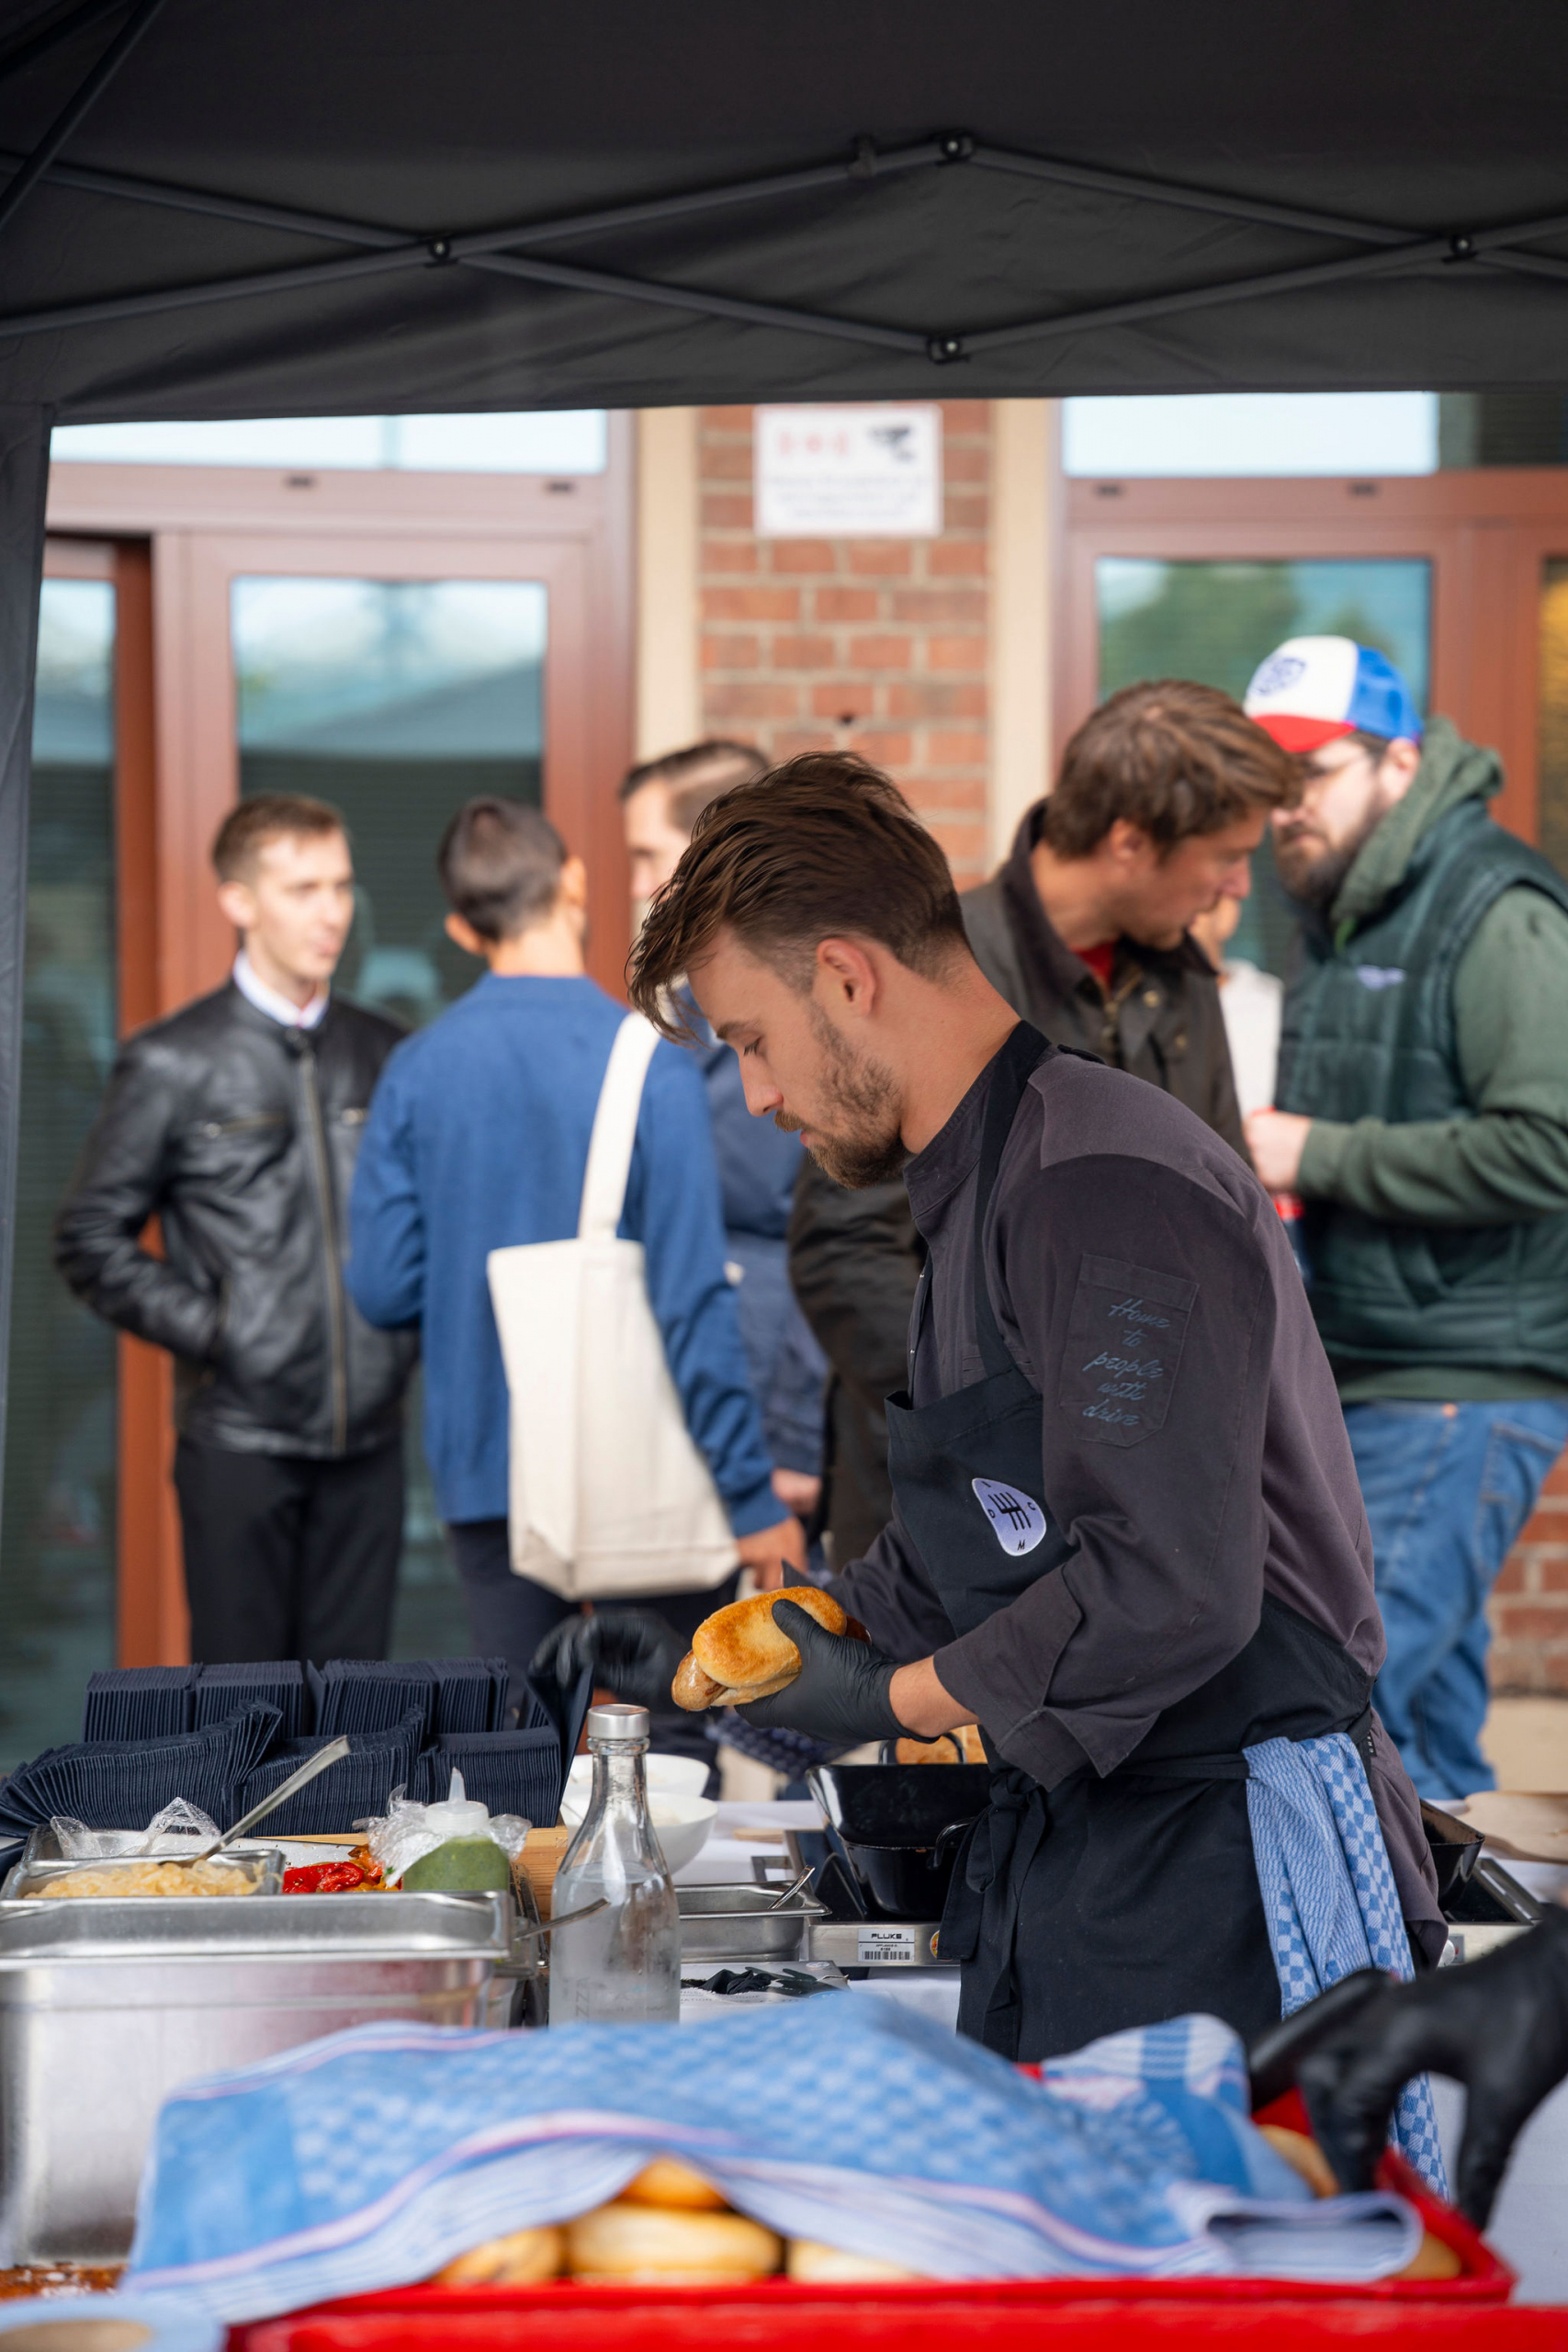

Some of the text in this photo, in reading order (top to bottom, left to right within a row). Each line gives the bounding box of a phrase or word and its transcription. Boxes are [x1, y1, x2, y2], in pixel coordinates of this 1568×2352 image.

[1108, 1298, 1171, 1329] Home
[1122, 1329, 1147, 1348] to
[1082, 1351, 1164, 1379] people
[1096, 1381, 1147, 1401] with
[1082, 1398, 1140, 1426] drive
